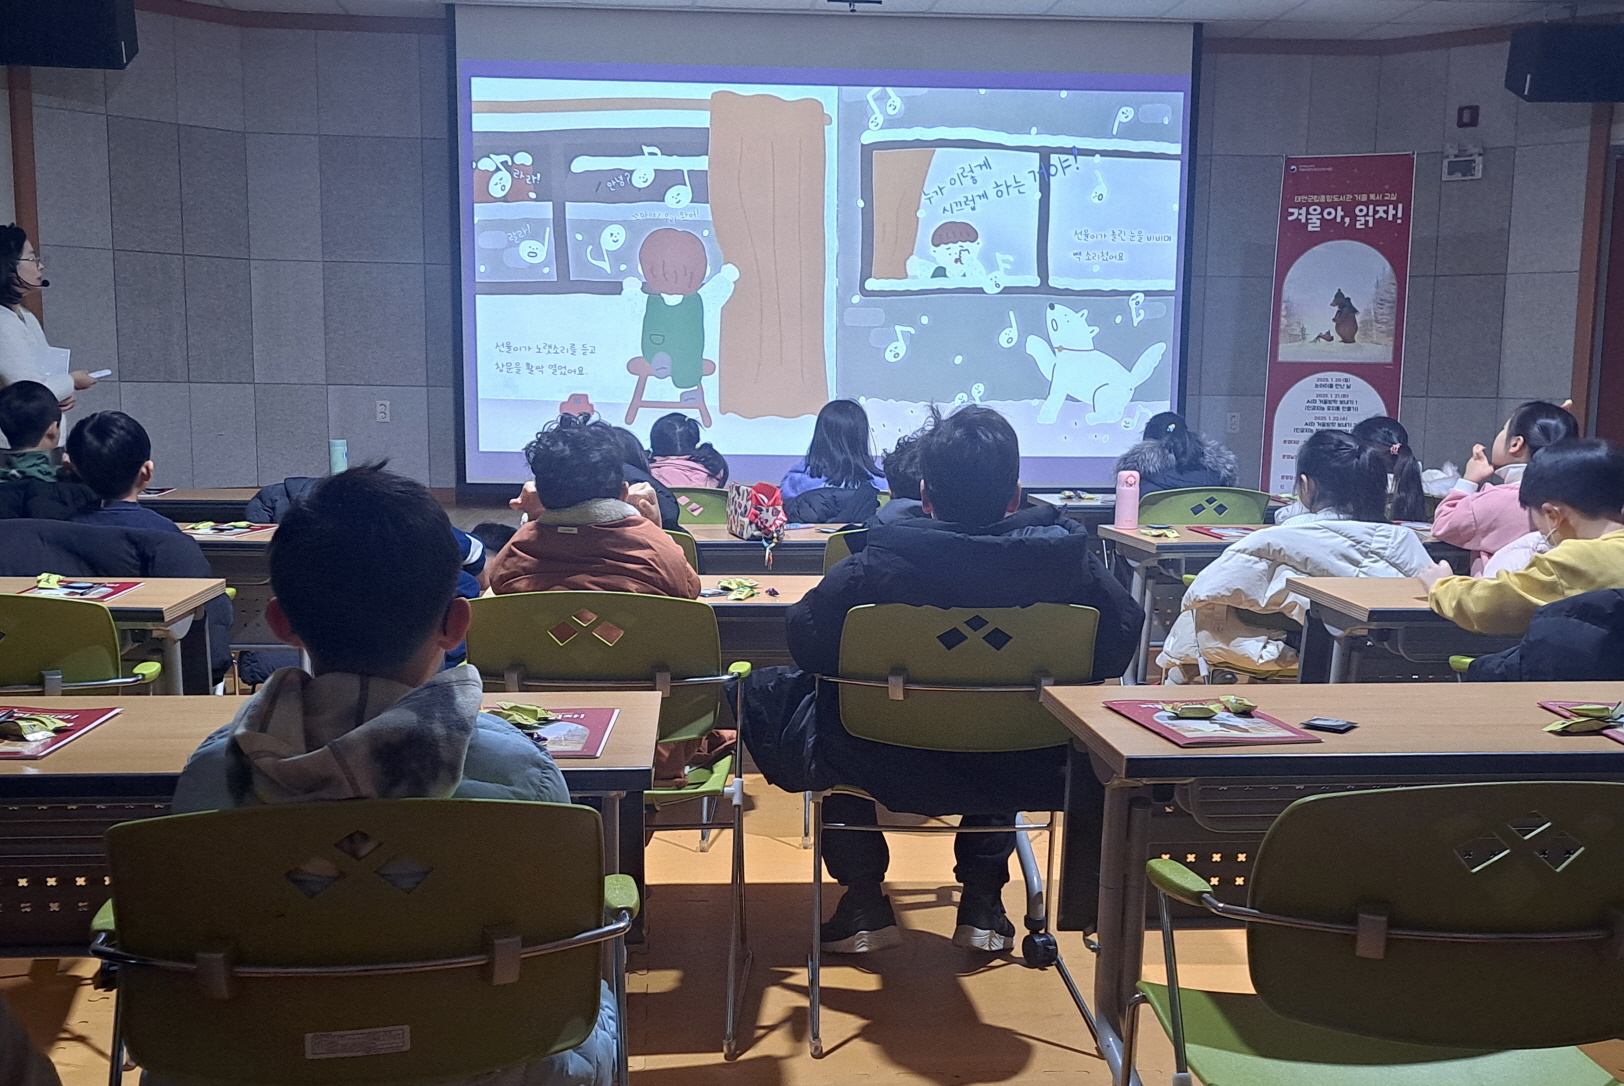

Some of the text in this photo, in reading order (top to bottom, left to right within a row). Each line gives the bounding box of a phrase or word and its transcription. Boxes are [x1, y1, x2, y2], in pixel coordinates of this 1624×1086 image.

[606, 172, 631, 192] 안녕?
[921, 156, 993, 205] 누가 이렇게
[942, 145, 1080, 215] 시끄럽게 하는 거야!
[664, 212, 677, 224] 우리
[680, 208, 700, 222] 왔어!
[1287, 203, 1404, 231] 겨울아, 읽자!
[1073, 228, 1107, 242] 선율이가
[1110, 229, 1126, 242] 졸린
[1129, 230, 1144, 242] 눈을
[1085, 250, 1127, 262] 소리쳤어요.
[535, 342, 577, 356] 노랫소리를
[581, 343, 596, 356] 듣고
[495, 361, 522, 375] 창문을
[548, 363, 589, 376] 열었어요.
